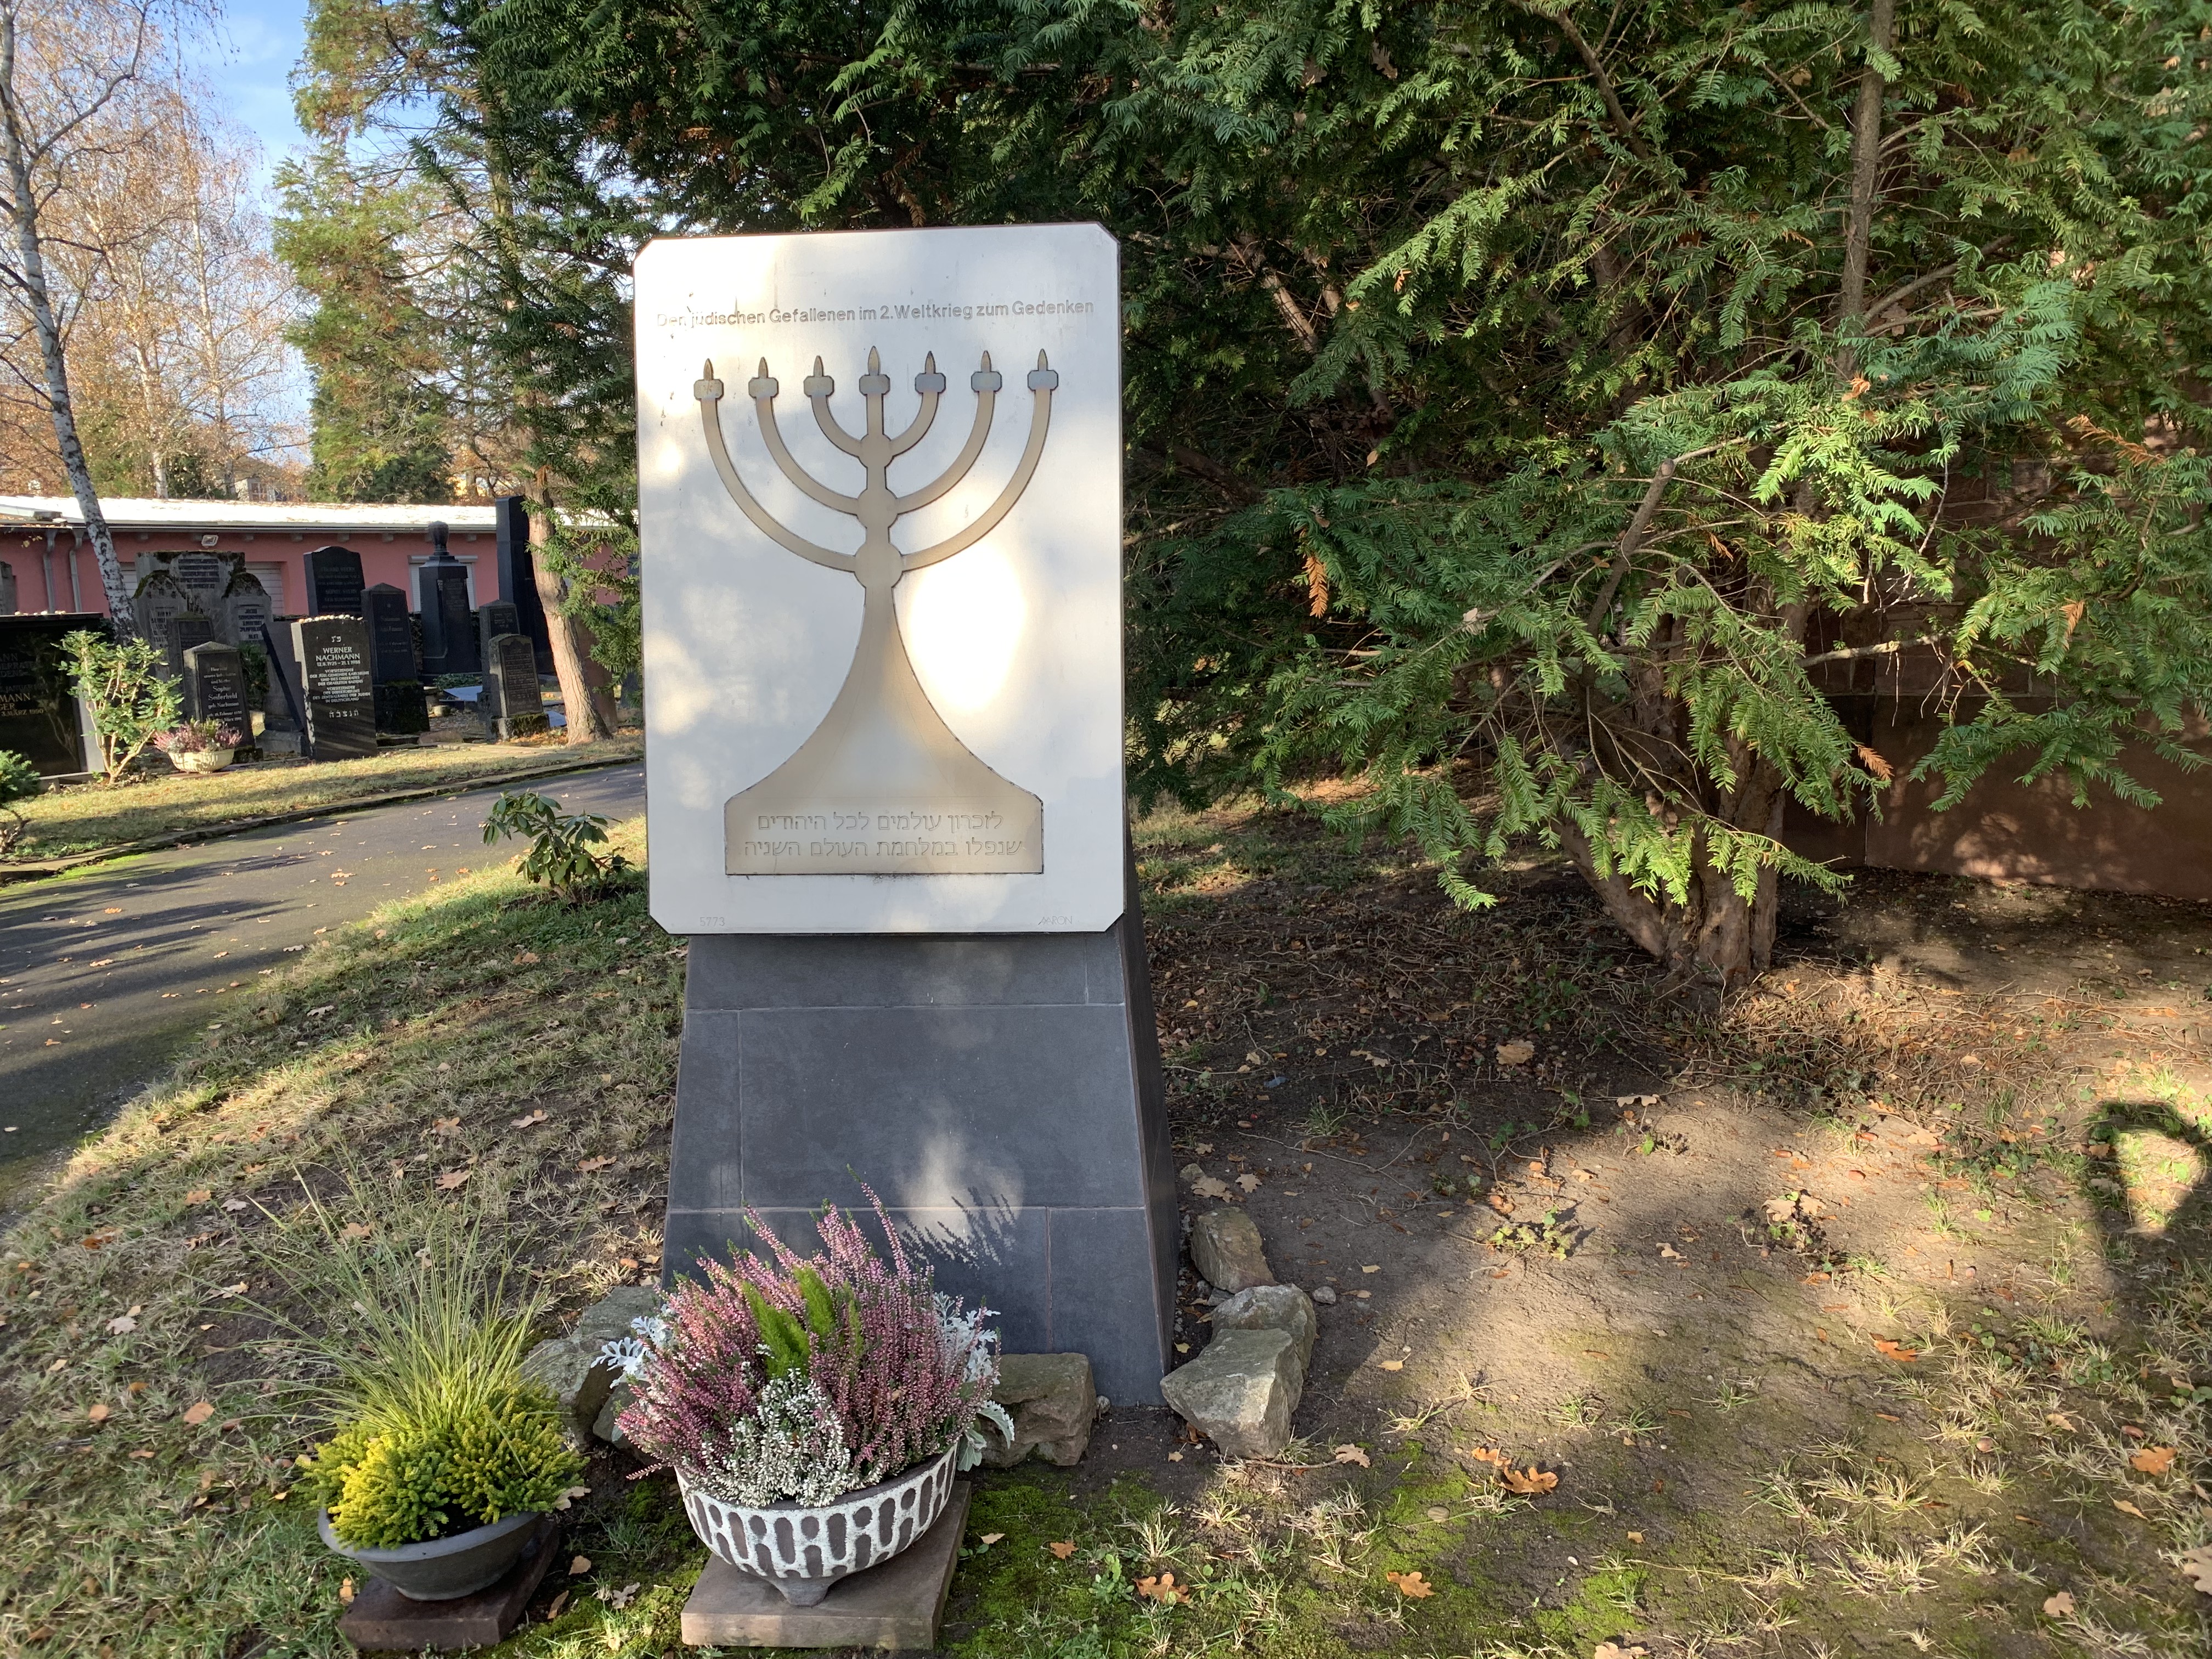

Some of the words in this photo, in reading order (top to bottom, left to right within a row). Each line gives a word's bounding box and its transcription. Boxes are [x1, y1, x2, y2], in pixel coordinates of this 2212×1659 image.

[658, 314, 686, 326] Den
[691, 311, 766, 329] jüdischen
[769, 308, 856, 323] Gefallenen
[859, 306, 877, 320] im
[976, 304, 1009, 317] zum
[1012, 300, 1094, 315] Gedenken
[758, 815, 827, 830] היהודים
[833, 811, 870, 831] לכל
[878, 811, 941, 831] עולמים
[948, 810, 1004, 833] לזכרון
[745, 841, 800, 856] השניה
[810, 838, 868, 857] העולם
[877, 837, 958, 856] במלחמת
[966, 837, 1023, 856] שנפלו
[699, 917, 725, 926] 5773
[1038, 916, 1073, 926] AARON
